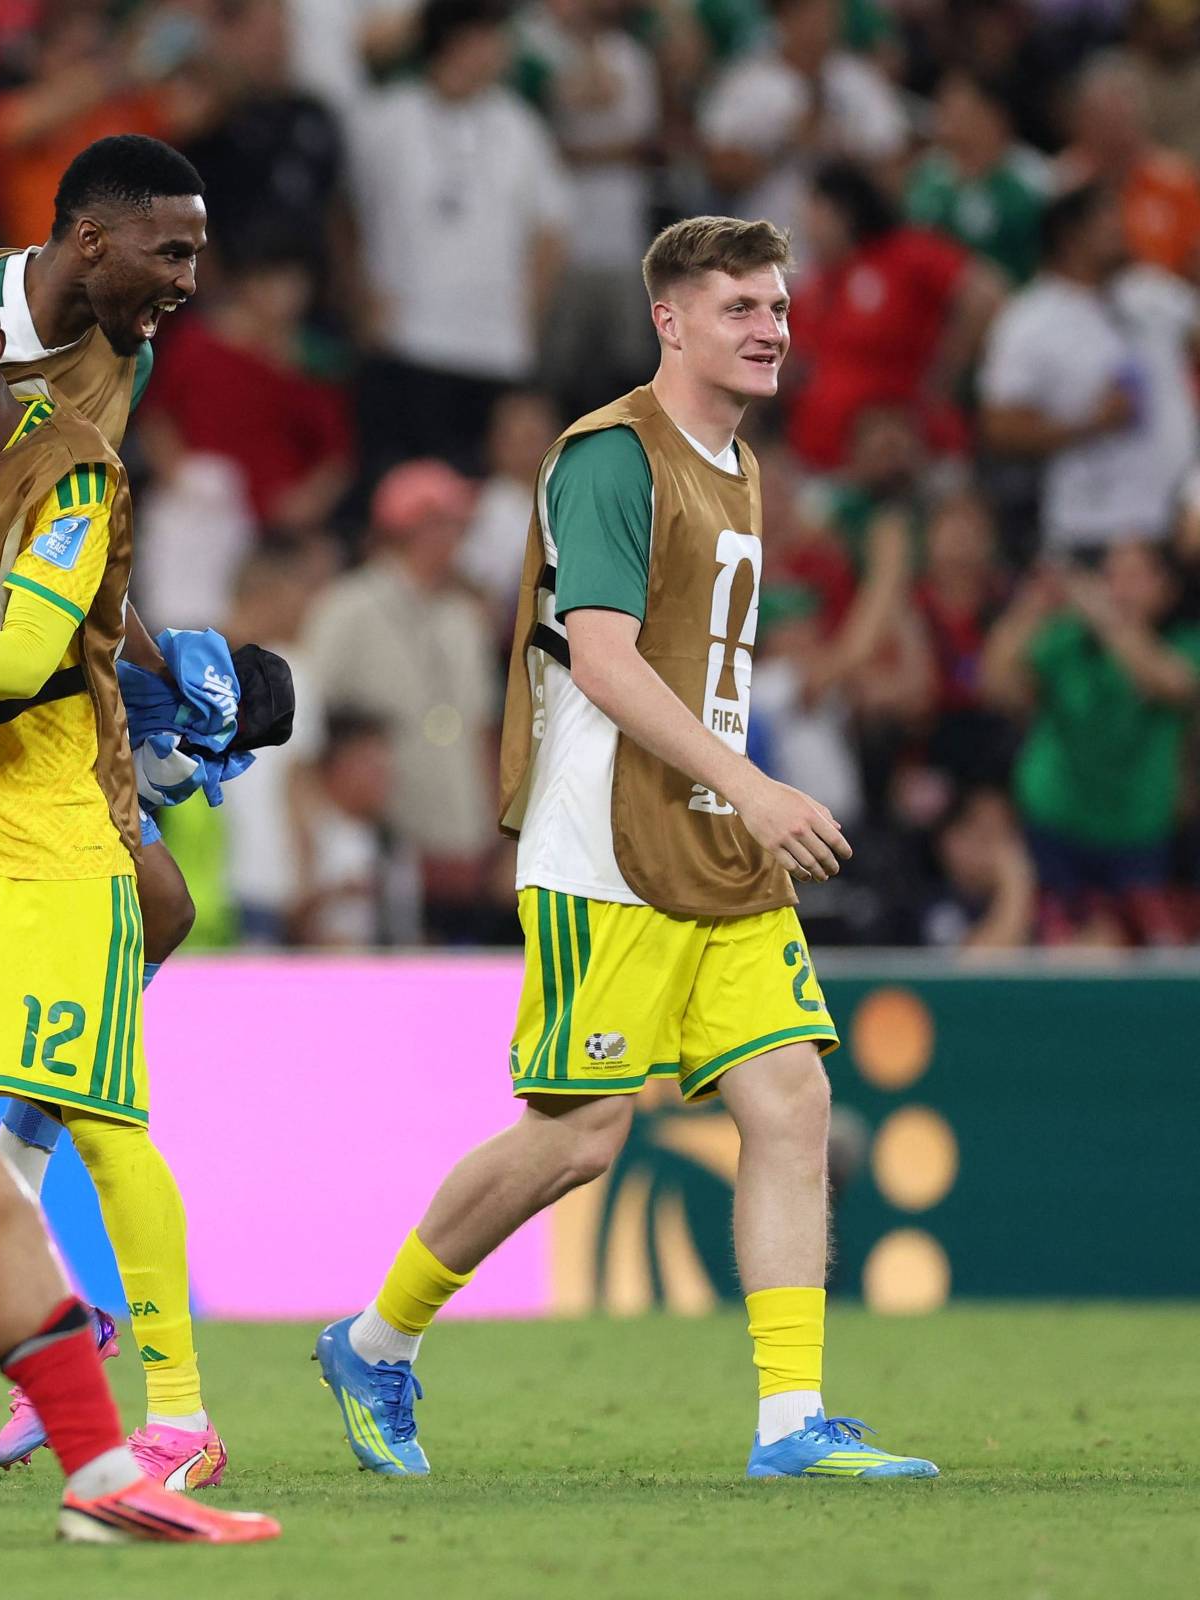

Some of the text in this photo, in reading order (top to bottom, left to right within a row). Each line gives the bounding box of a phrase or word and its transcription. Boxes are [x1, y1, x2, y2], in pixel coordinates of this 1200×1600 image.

[712, 708, 744, 735] FIFA
[783, 940, 823, 1013] 2
[21, 994, 86, 1077] 12
